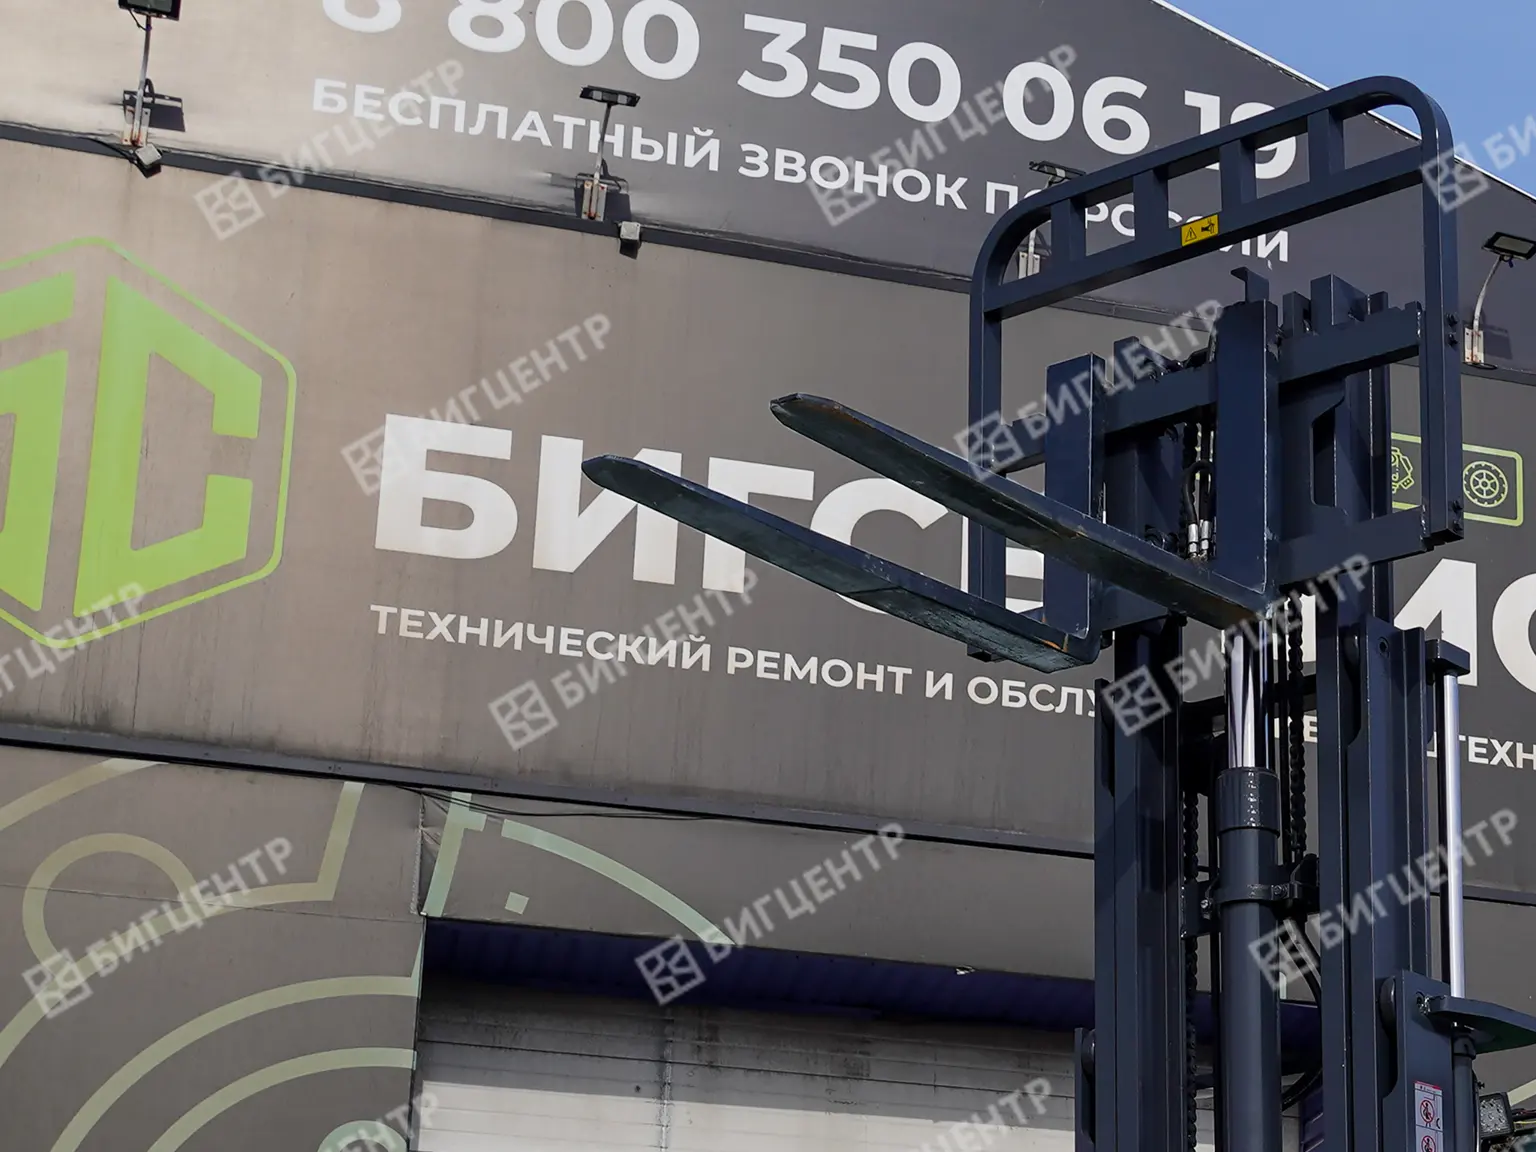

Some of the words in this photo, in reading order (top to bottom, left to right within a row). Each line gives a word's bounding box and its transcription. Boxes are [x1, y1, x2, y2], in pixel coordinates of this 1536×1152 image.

[312, 77, 720, 172] БЕСПЛАТНЫЙ
[738, 142, 967, 210] ЗВОНОК
[448, 0, 700, 81] 800
[737, 13, 962, 123] 350
[1003, 61, 1151, 156] 06
[369, 604, 711, 673] ТЕХНИЧЕСКИЙ
[727, 645, 912, 696] РЕМОНТ
[924, 670, 954, 701] И
